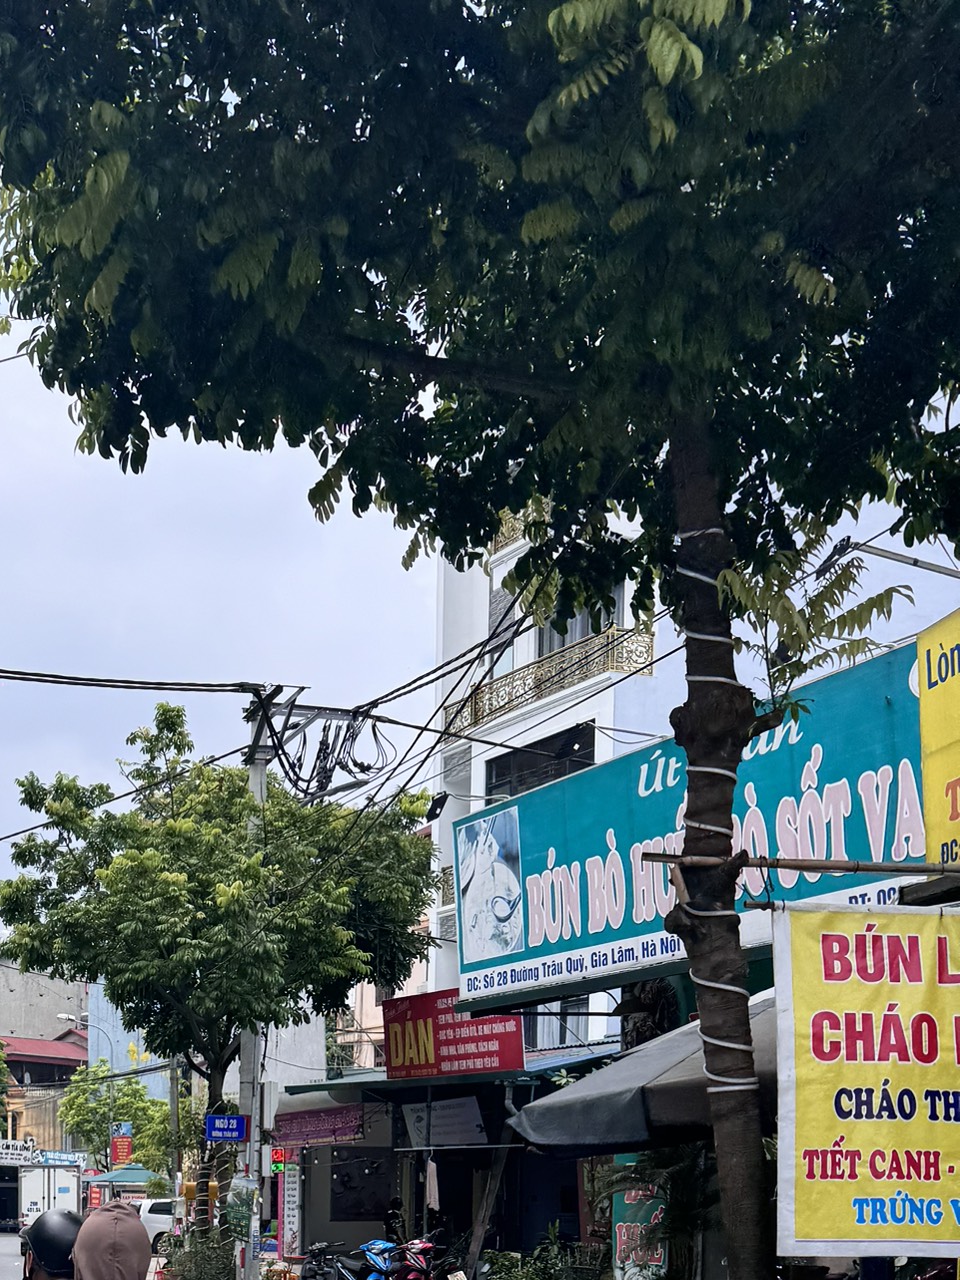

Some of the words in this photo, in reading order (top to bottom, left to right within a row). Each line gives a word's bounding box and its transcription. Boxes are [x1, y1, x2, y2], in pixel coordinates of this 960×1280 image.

[926, 642, 960, 691] Lòn
[637, 749, 682, 798] Út
[527, 846, 583, 948] BÚN
[586, 827, 626, 934] BÒ
[775, 743, 852, 889] SỐT
[857, 757, 926, 863] VA
[467, 976, 481, 993] ĐC:
[483, 970, 496, 989] Số
[497, 971, 508, 987] 28
[510, 966, 539, 984] Đường
[541, 961, 563, 978] Trâu
[591, 951, 608, 968] Gia
[611, 946, 639, 964] Lâm,
[641, 938, 657, 959] Hà
[660, 935, 681, 958] Nội
[820, 923, 923, 984] BÚN
[937, 935, 960, 985] L
[389, 1010, 436, 1067] DÁN
[811, 1002, 939, 1065] CHÁO
[229, 1119, 237, 1129] 28
[834, 1078, 916, 1121] CHÁO
[924, 1089, 960, 1122] TH
[802, 1135, 861, 1181] TIẾT
[868, 1149, 941, 1182] CANH
[852, 1190, 944, 1225] TRỨNG
